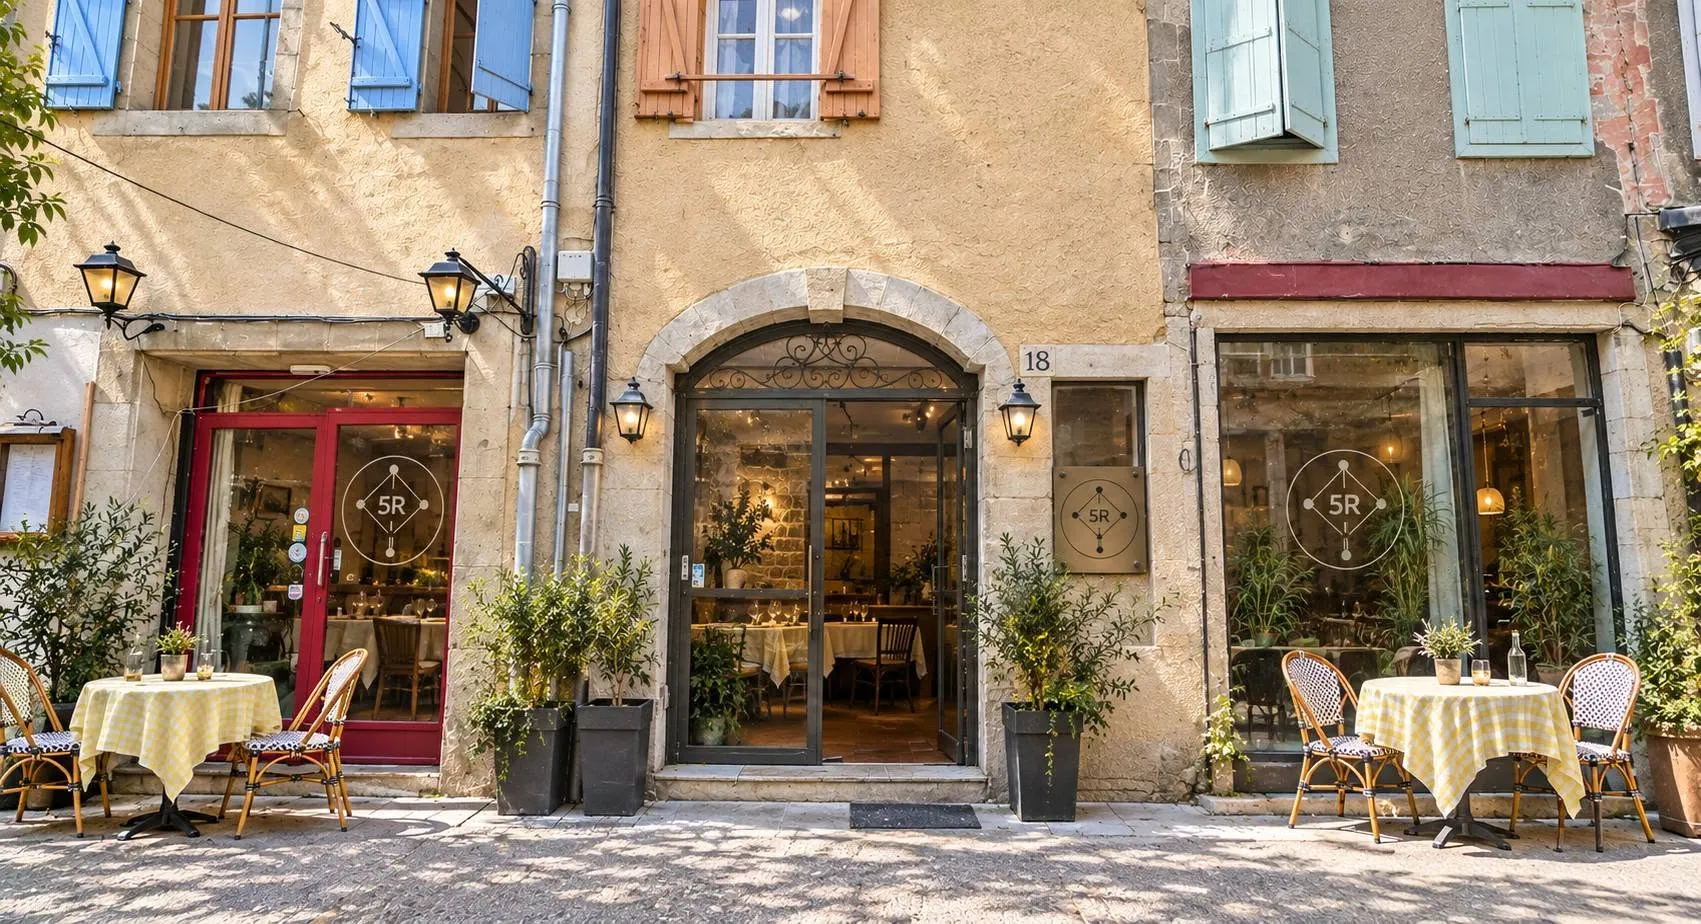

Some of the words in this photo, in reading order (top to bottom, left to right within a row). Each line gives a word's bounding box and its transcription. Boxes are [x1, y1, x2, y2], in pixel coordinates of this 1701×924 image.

[1025, 350, 1050, 371] 18
[377, 495, 406, 515] 5R
[1328, 494, 1361, 515] 5R
[1089, 509, 1110, 523] 5R
